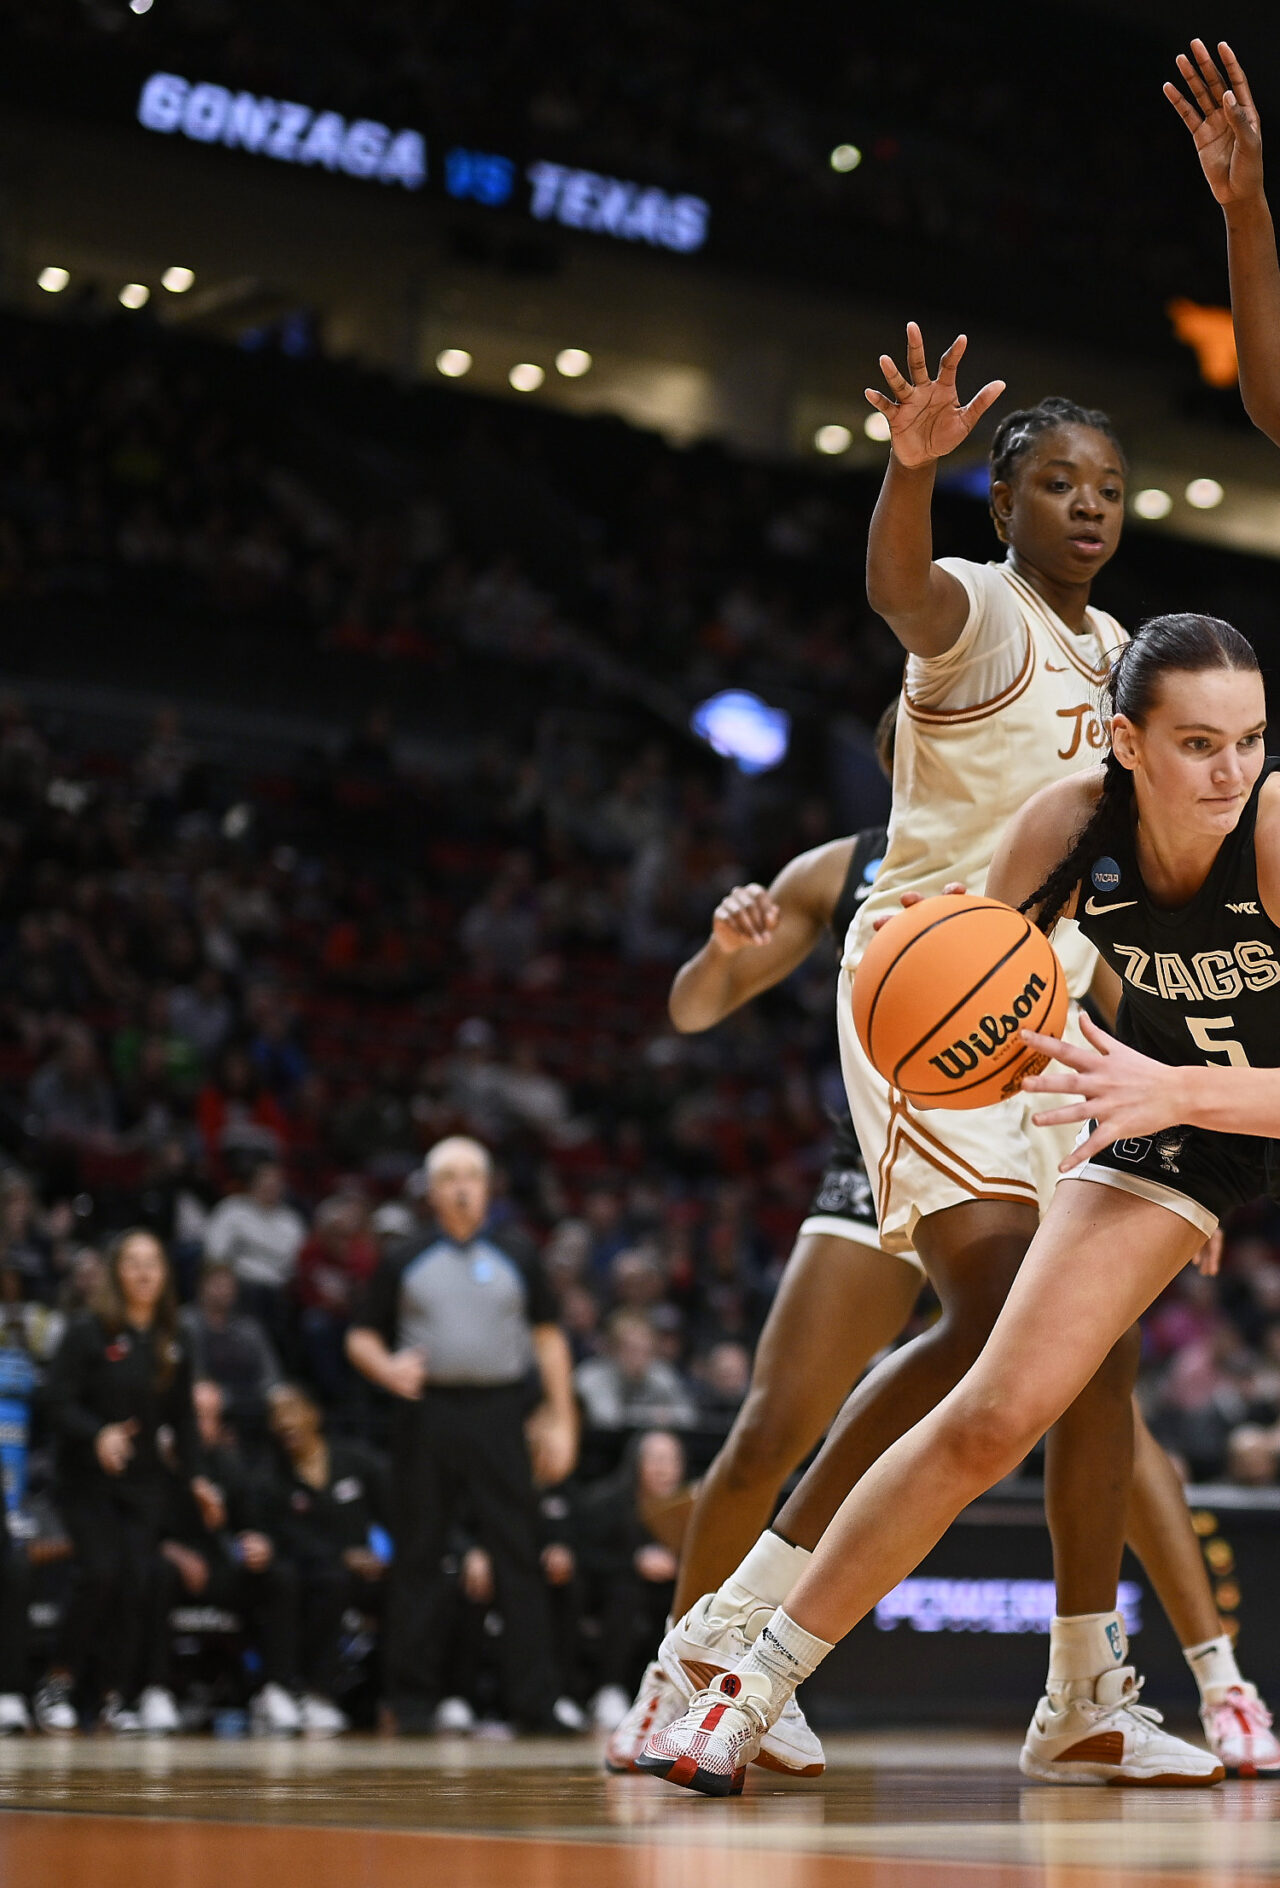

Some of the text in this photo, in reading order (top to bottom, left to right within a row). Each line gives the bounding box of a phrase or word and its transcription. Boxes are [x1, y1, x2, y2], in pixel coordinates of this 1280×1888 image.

[138, 71, 427, 191] GONZAGA
[526, 159, 710, 253] TEXAS
[1094, 872, 1119, 883] NCAA
[928, 972, 1047, 1080] Wilson
[1184, 1015, 1252, 1068] 5
